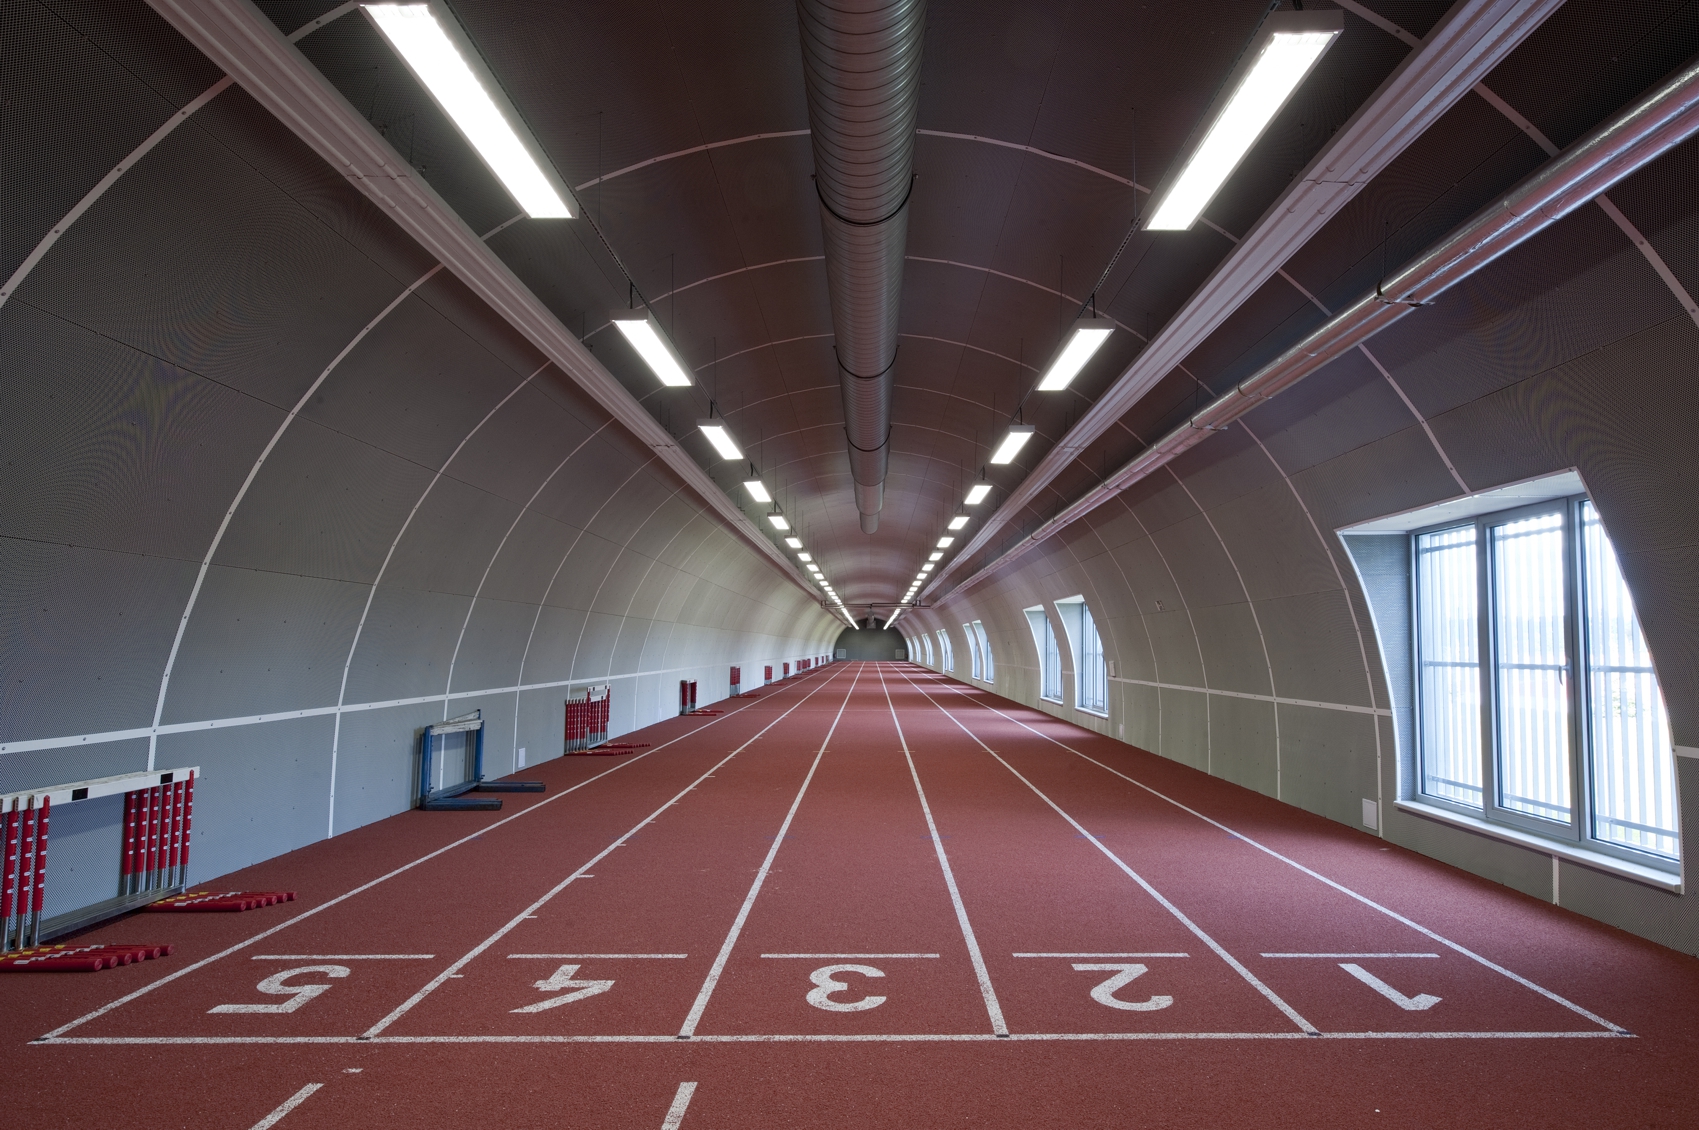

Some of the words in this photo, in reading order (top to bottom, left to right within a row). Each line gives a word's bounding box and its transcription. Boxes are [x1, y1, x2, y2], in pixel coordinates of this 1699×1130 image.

[206, 965, 352, 1014] 5
[508, 964, 616, 1013] 4
[806, 964, 887, 1012] 3
[1071, 963, 1174, 1011] 2
[1338, 963, 1442, 1011] 1
